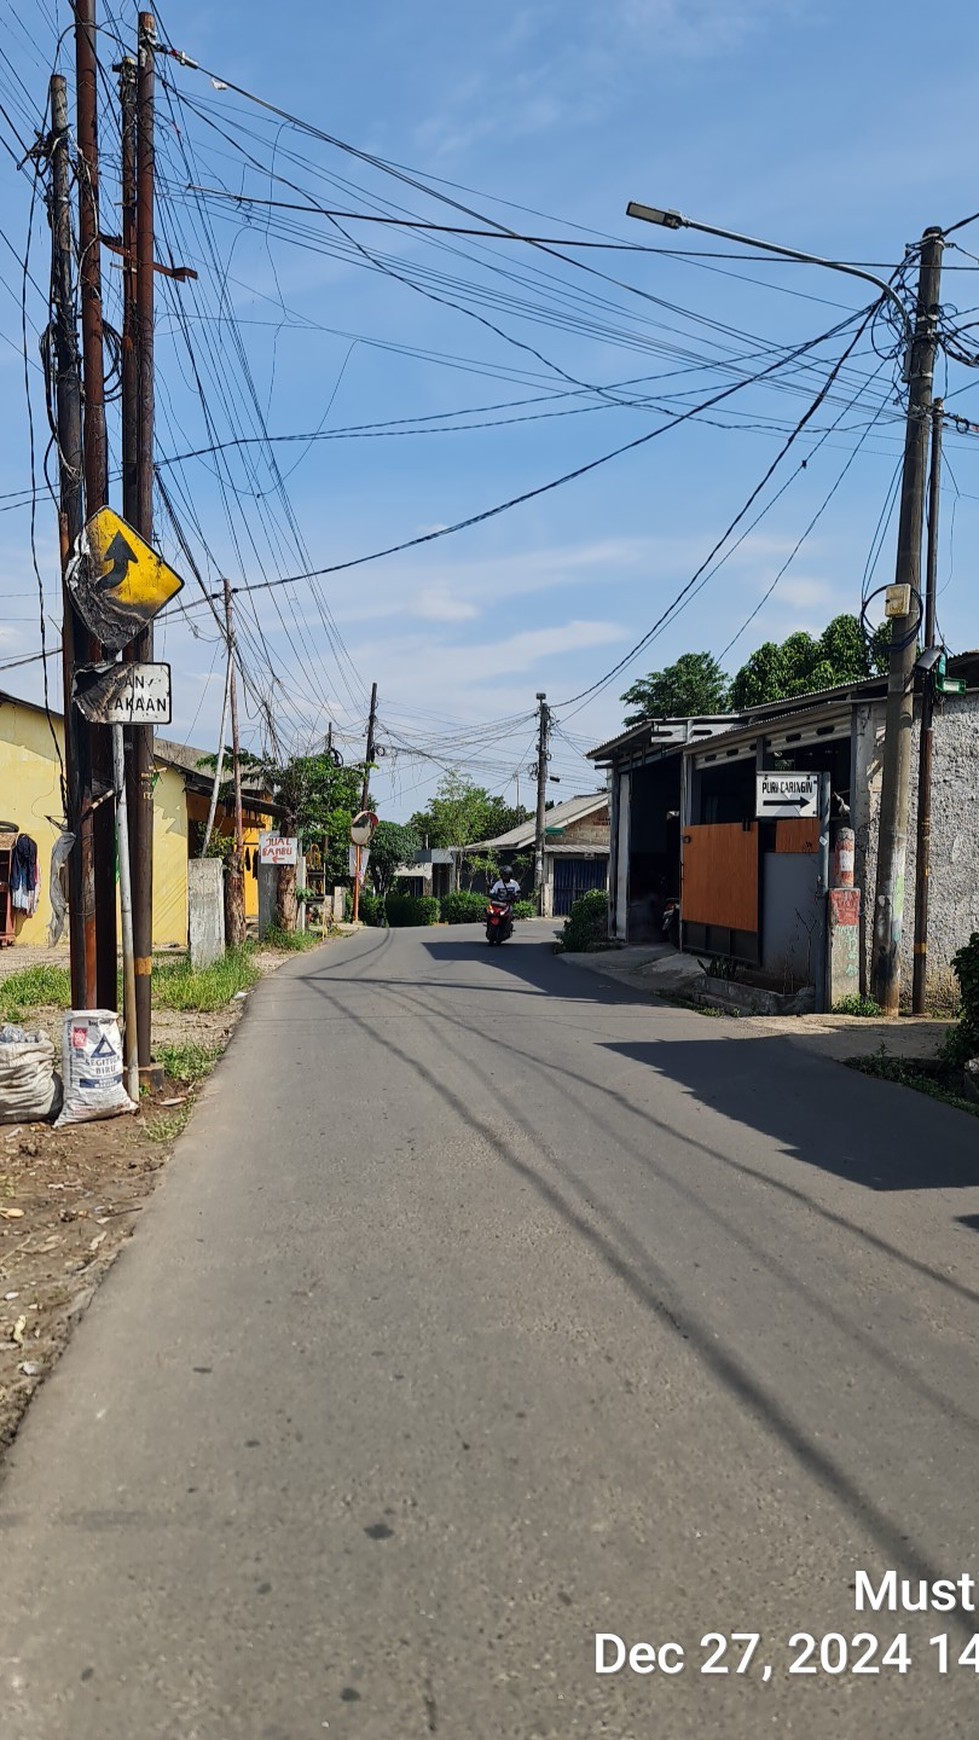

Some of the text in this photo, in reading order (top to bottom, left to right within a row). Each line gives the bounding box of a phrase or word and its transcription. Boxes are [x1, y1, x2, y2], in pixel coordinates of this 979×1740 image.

[762, 781, 813, 794] PURI CARINGIN
[266, 837, 292, 848] JUAL
[262, 847, 293, 857] BAMBU
